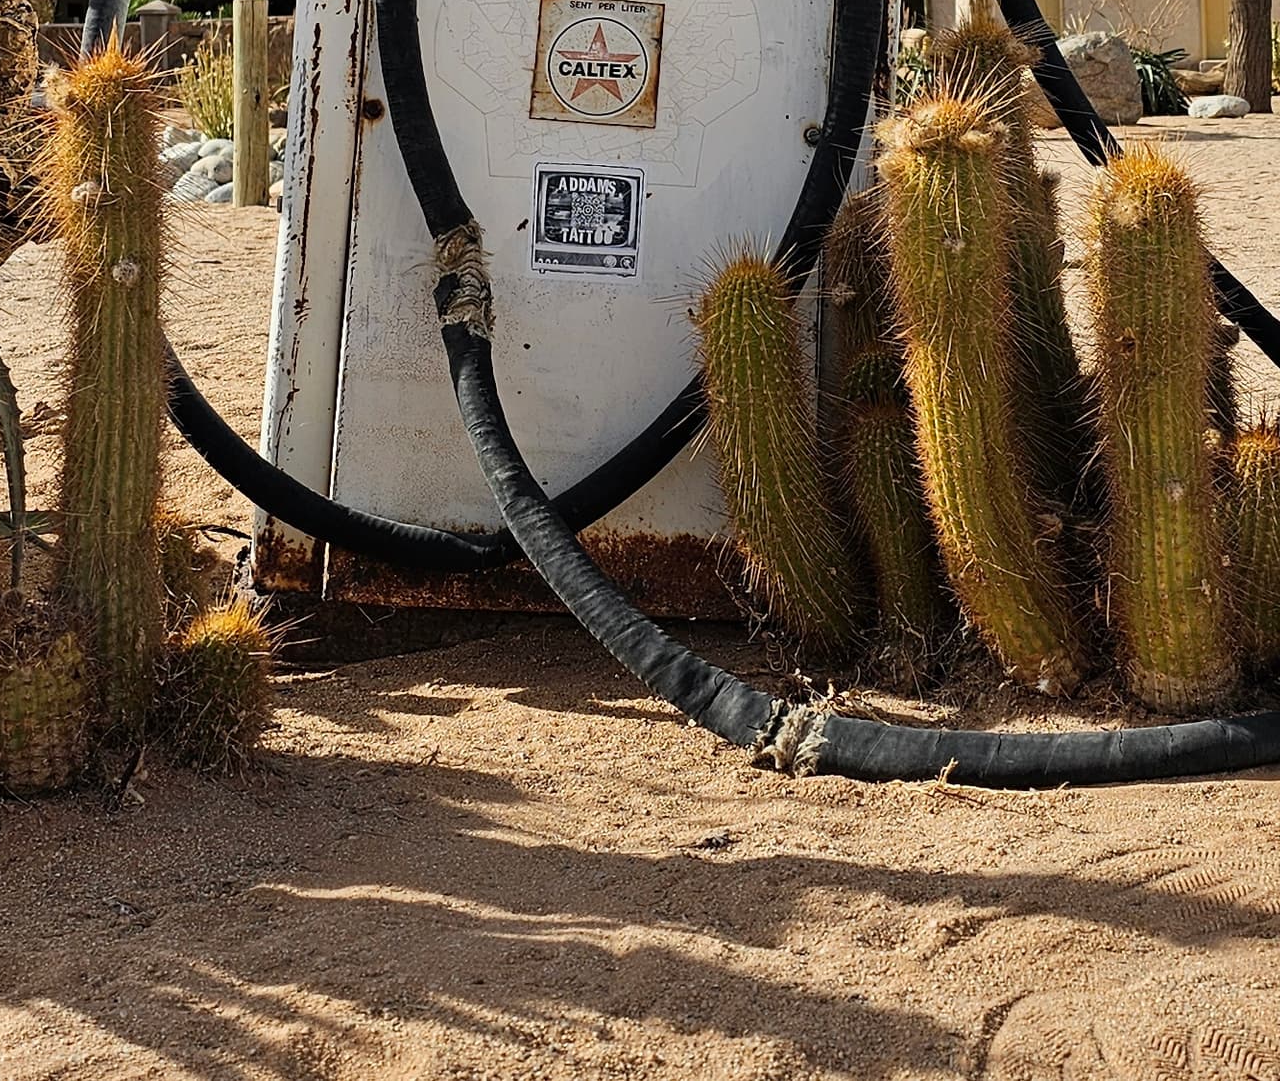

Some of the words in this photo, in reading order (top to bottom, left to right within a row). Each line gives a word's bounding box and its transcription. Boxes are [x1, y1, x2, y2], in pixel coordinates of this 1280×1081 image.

[570, 1, 592, 9] SENT
[599, 3, 615, 11] PER
[622, 5, 646, 13] LITER
[559, 61, 638, 79] CALTEX
[559, 177, 617, 196] ADDAMS
[561, 226, 615, 244] TATTOO
